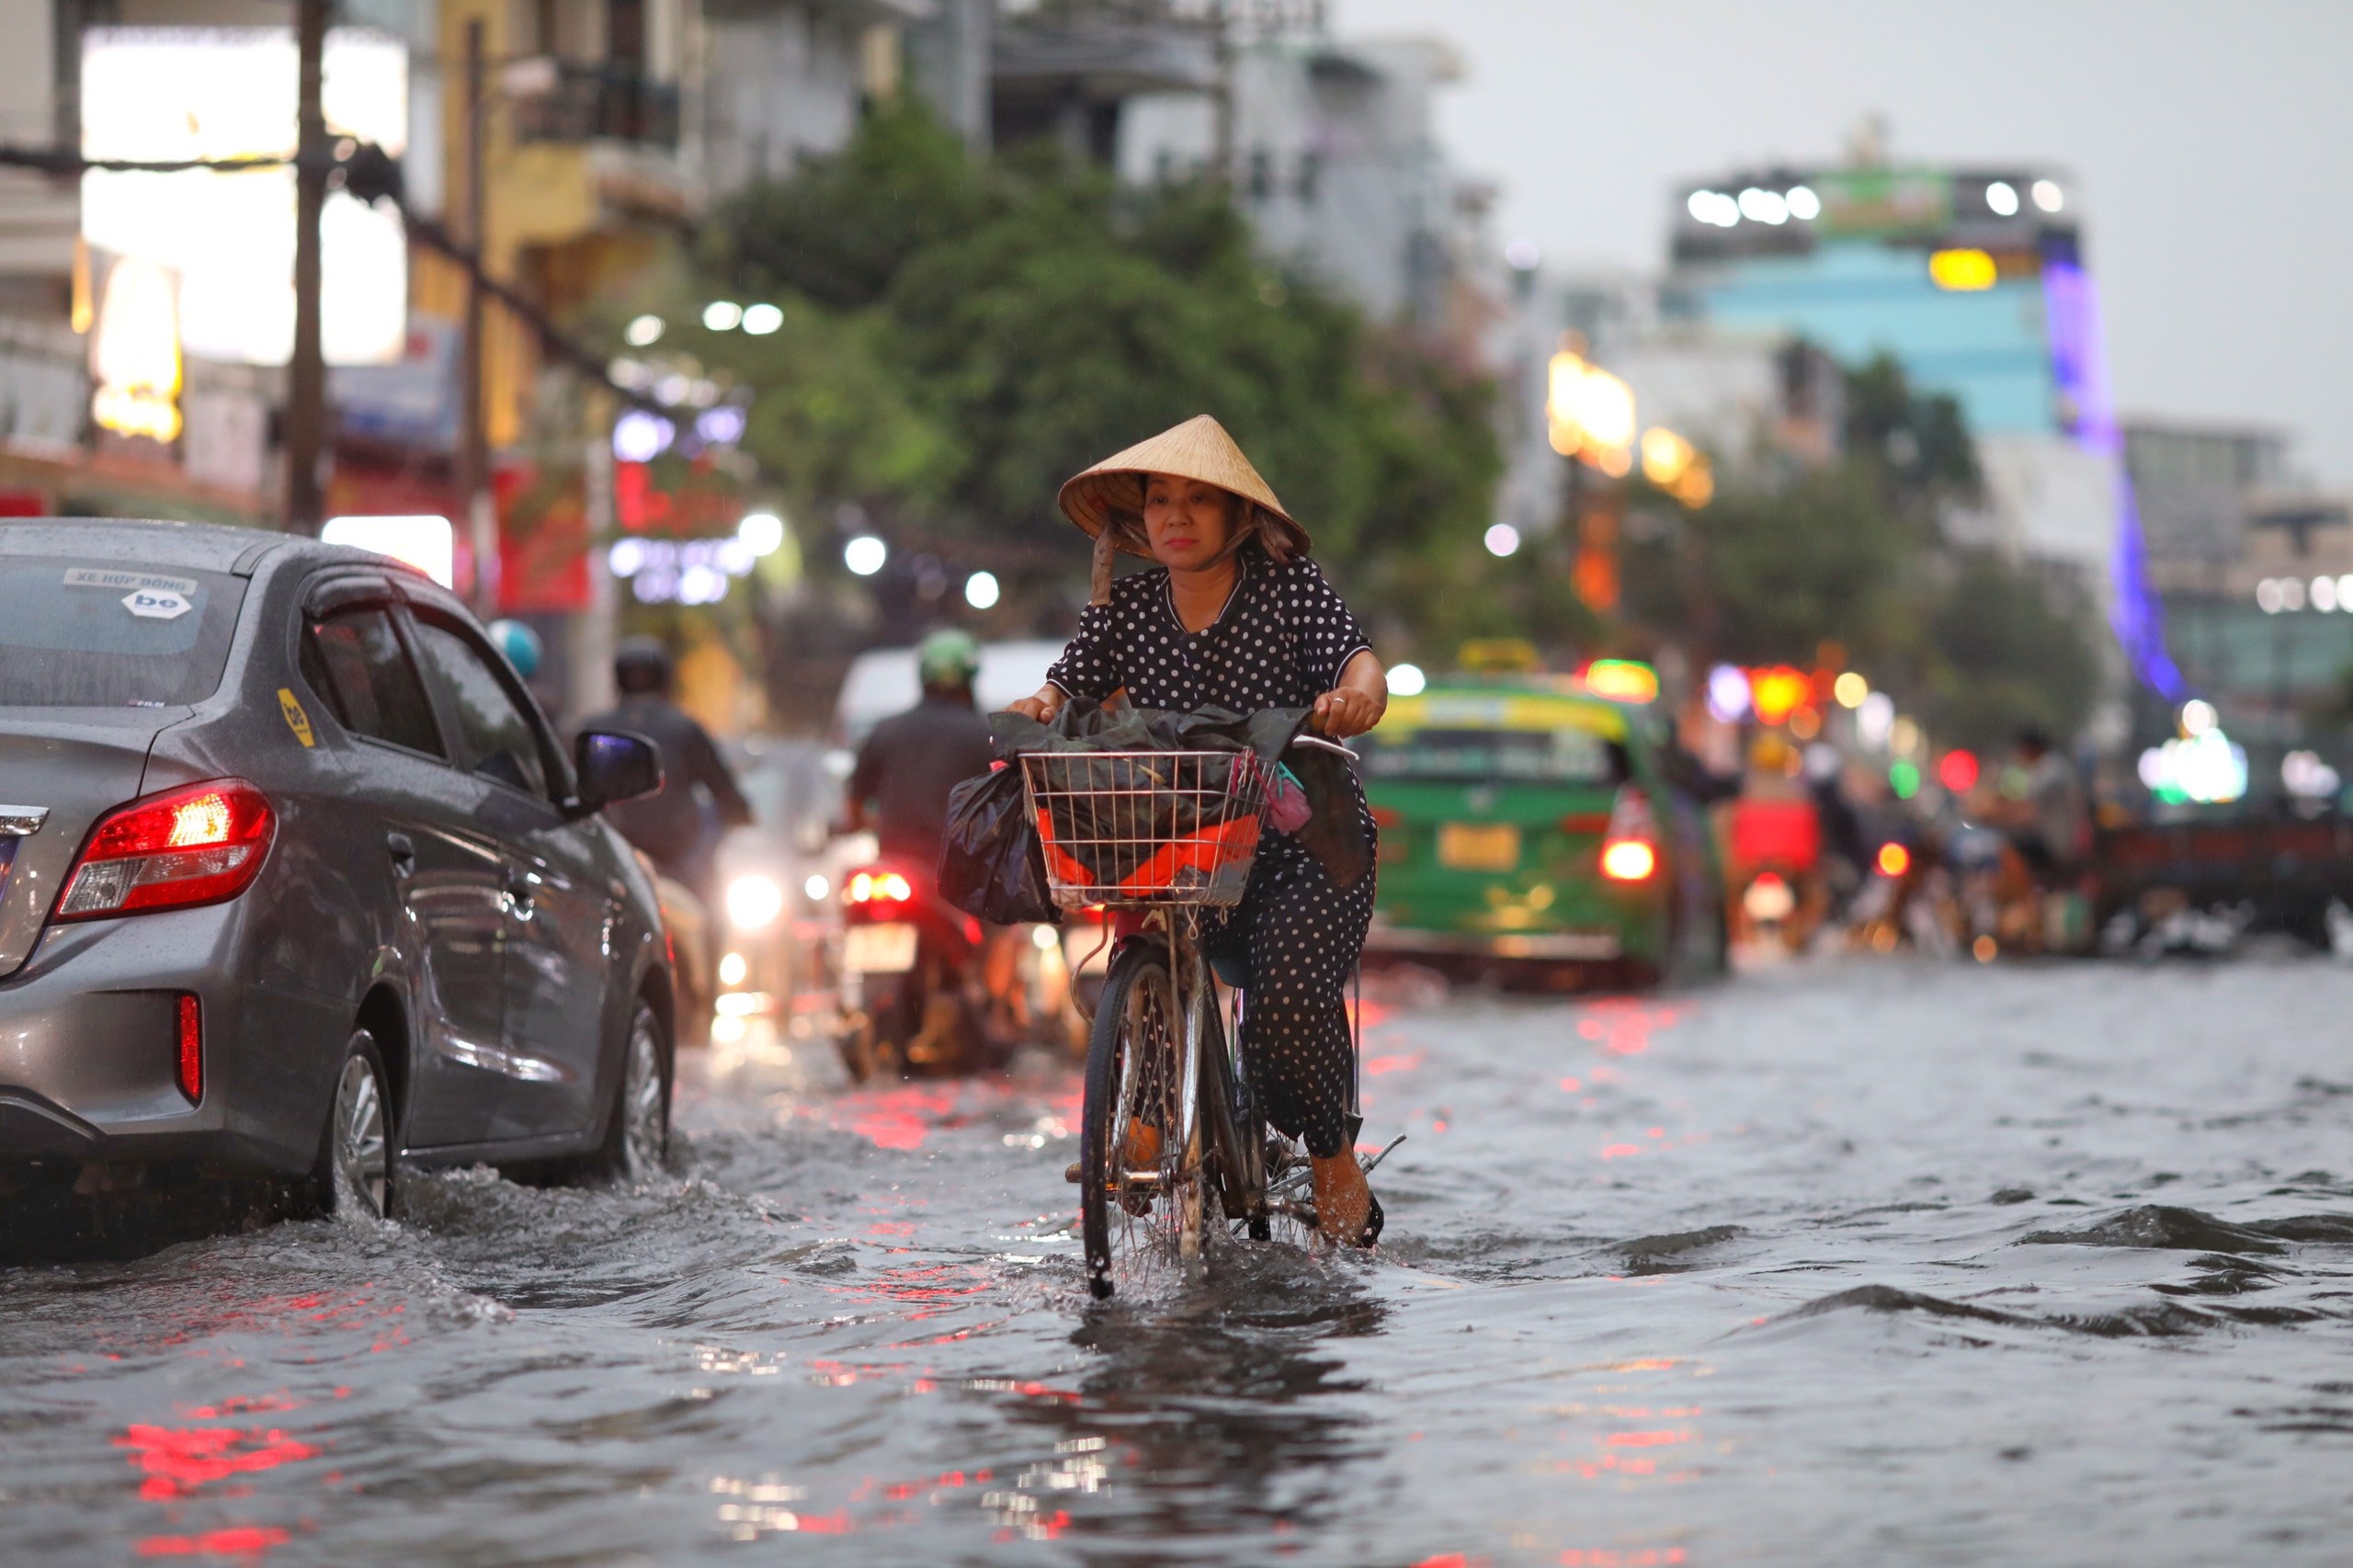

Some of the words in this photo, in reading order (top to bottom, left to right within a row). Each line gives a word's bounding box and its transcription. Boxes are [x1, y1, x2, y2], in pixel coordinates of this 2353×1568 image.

[76, 573, 97, 582] XE
[134, 594, 179, 608] be
[282, 702, 305, 726] be
